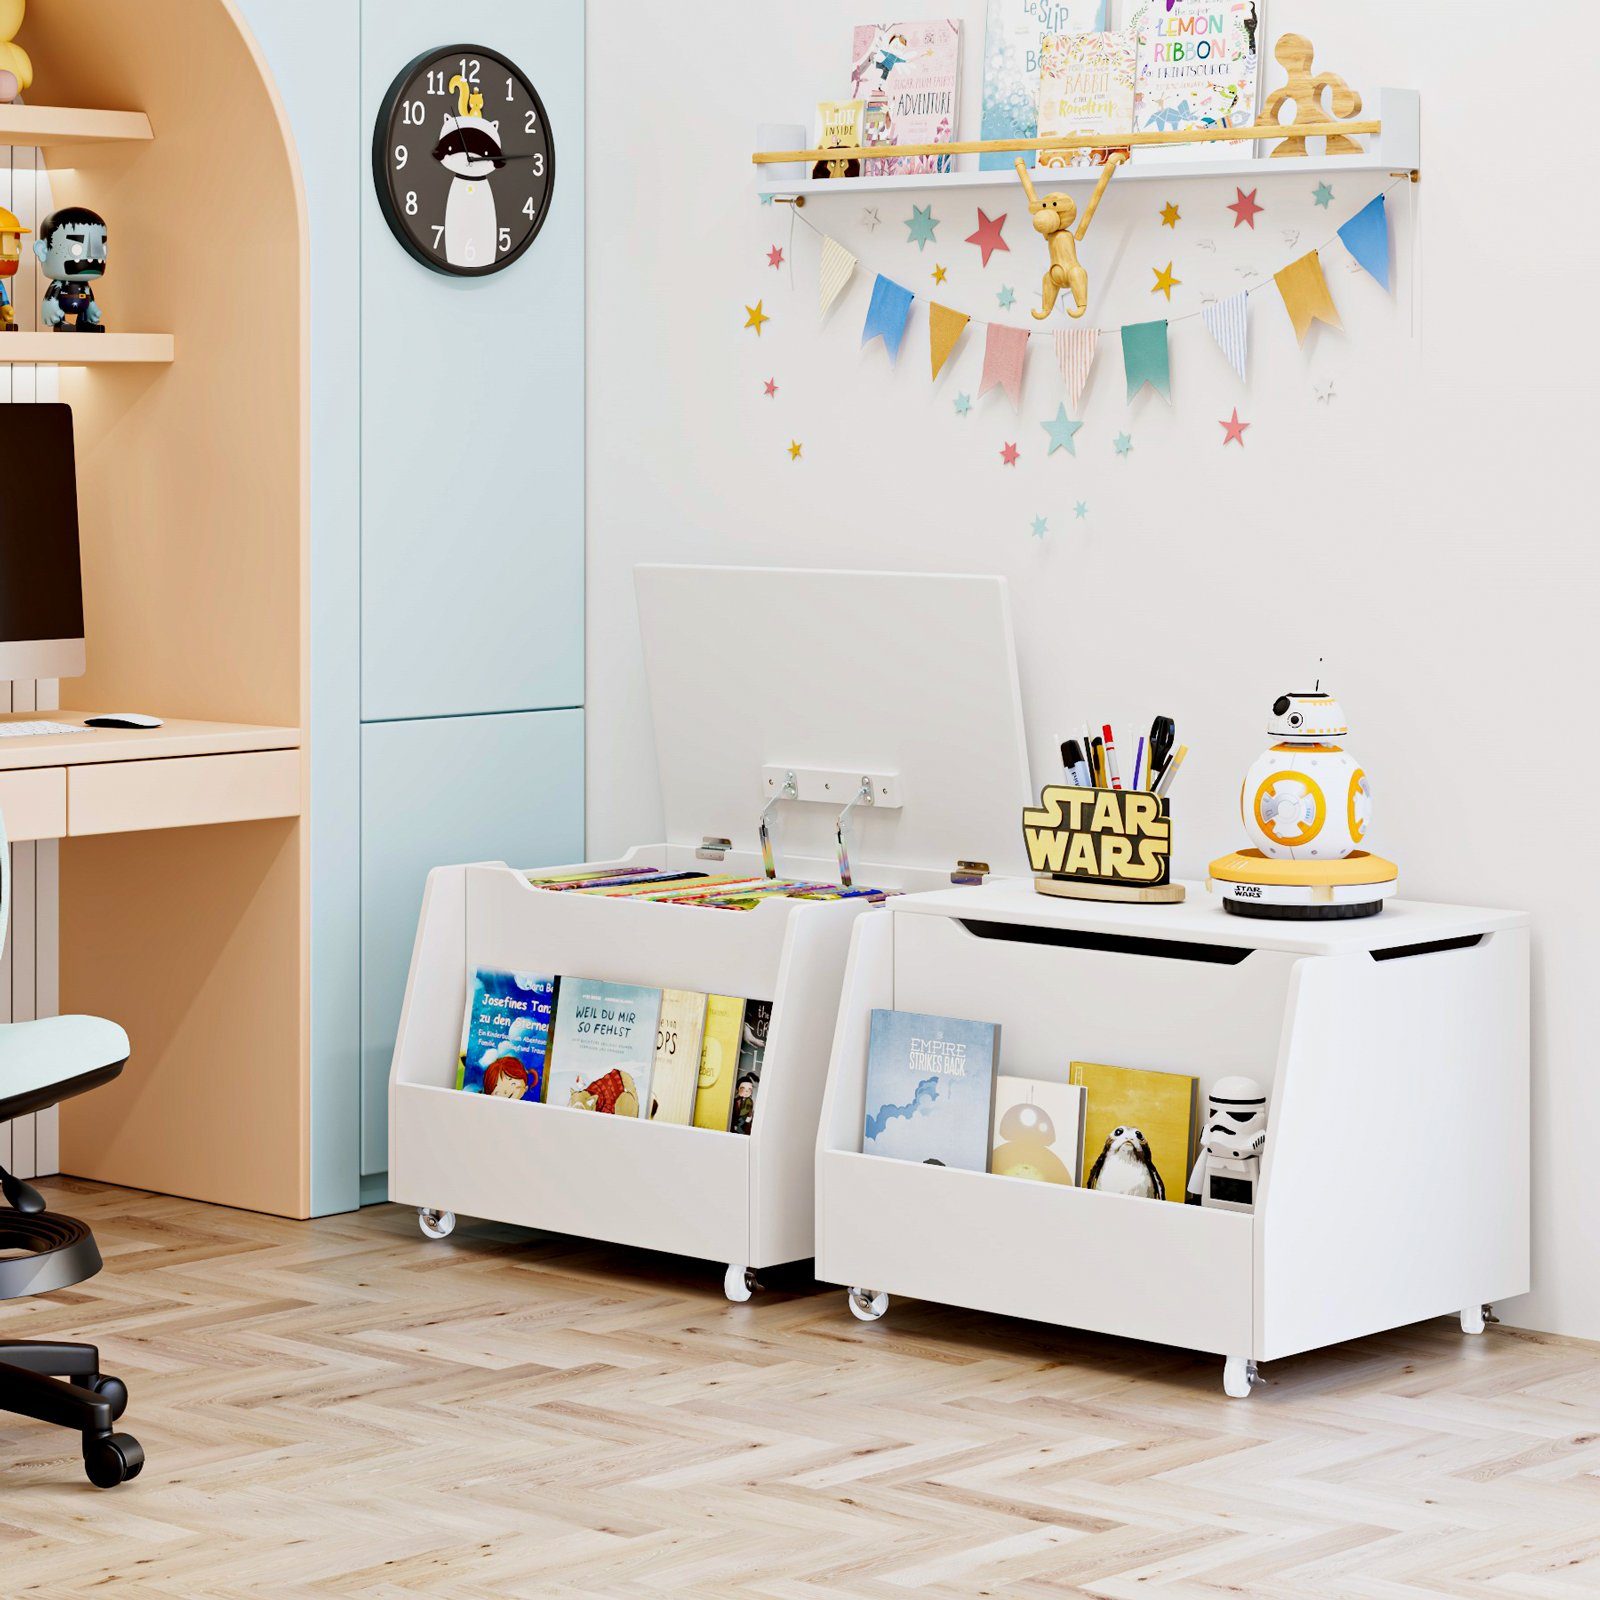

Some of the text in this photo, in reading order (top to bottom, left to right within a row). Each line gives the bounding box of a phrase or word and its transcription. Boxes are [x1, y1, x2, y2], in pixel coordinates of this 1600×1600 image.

[1155, 14, 1224, 37] LEMON
[1154, 39, 1226, 62] RIBBON
[459, 58, 481, 83] 12
[1157, 63, 1231, 78] PRINTSOURCE
[427, 71, 446, 96] 11
[505, 78, 514, 101] 1
[402, 100, 426, 126] 10
[896, 91, 952, 116] ADVENTURE
[524, 110, 537, 134] 2
[825, 125, 854, 137] INSIDE
[394, 145, 408, 170] 9
[532, 153, 544, 177] 3
[405, 191, 418, 216] 8
[522, 196, 535, 221] 4
[431, 225, 445, 250] 7
[499, 227, 512, 252] 5
[464, 238, 476, 262] 6
[1024, 787, 1169, 838] STAR
[1024, 827, 1169, 879] WARS
[1234, 885, 1262, 893] STAR
[1234, 890, 1262, 898] WARS
[481, 993, 528, 1011] Josefines
[479, 1014, 491, 1023] zu
[493, 1014, 511, 1027] den
[575, 1005, 636, 1024] WEIL DU MIR
[577, 1022, 632, 1038] SO FEHLST
[911, 1038, 967, 1058] EMPIRE
[909, 1052, 966, 1077] STRIKES BACK
